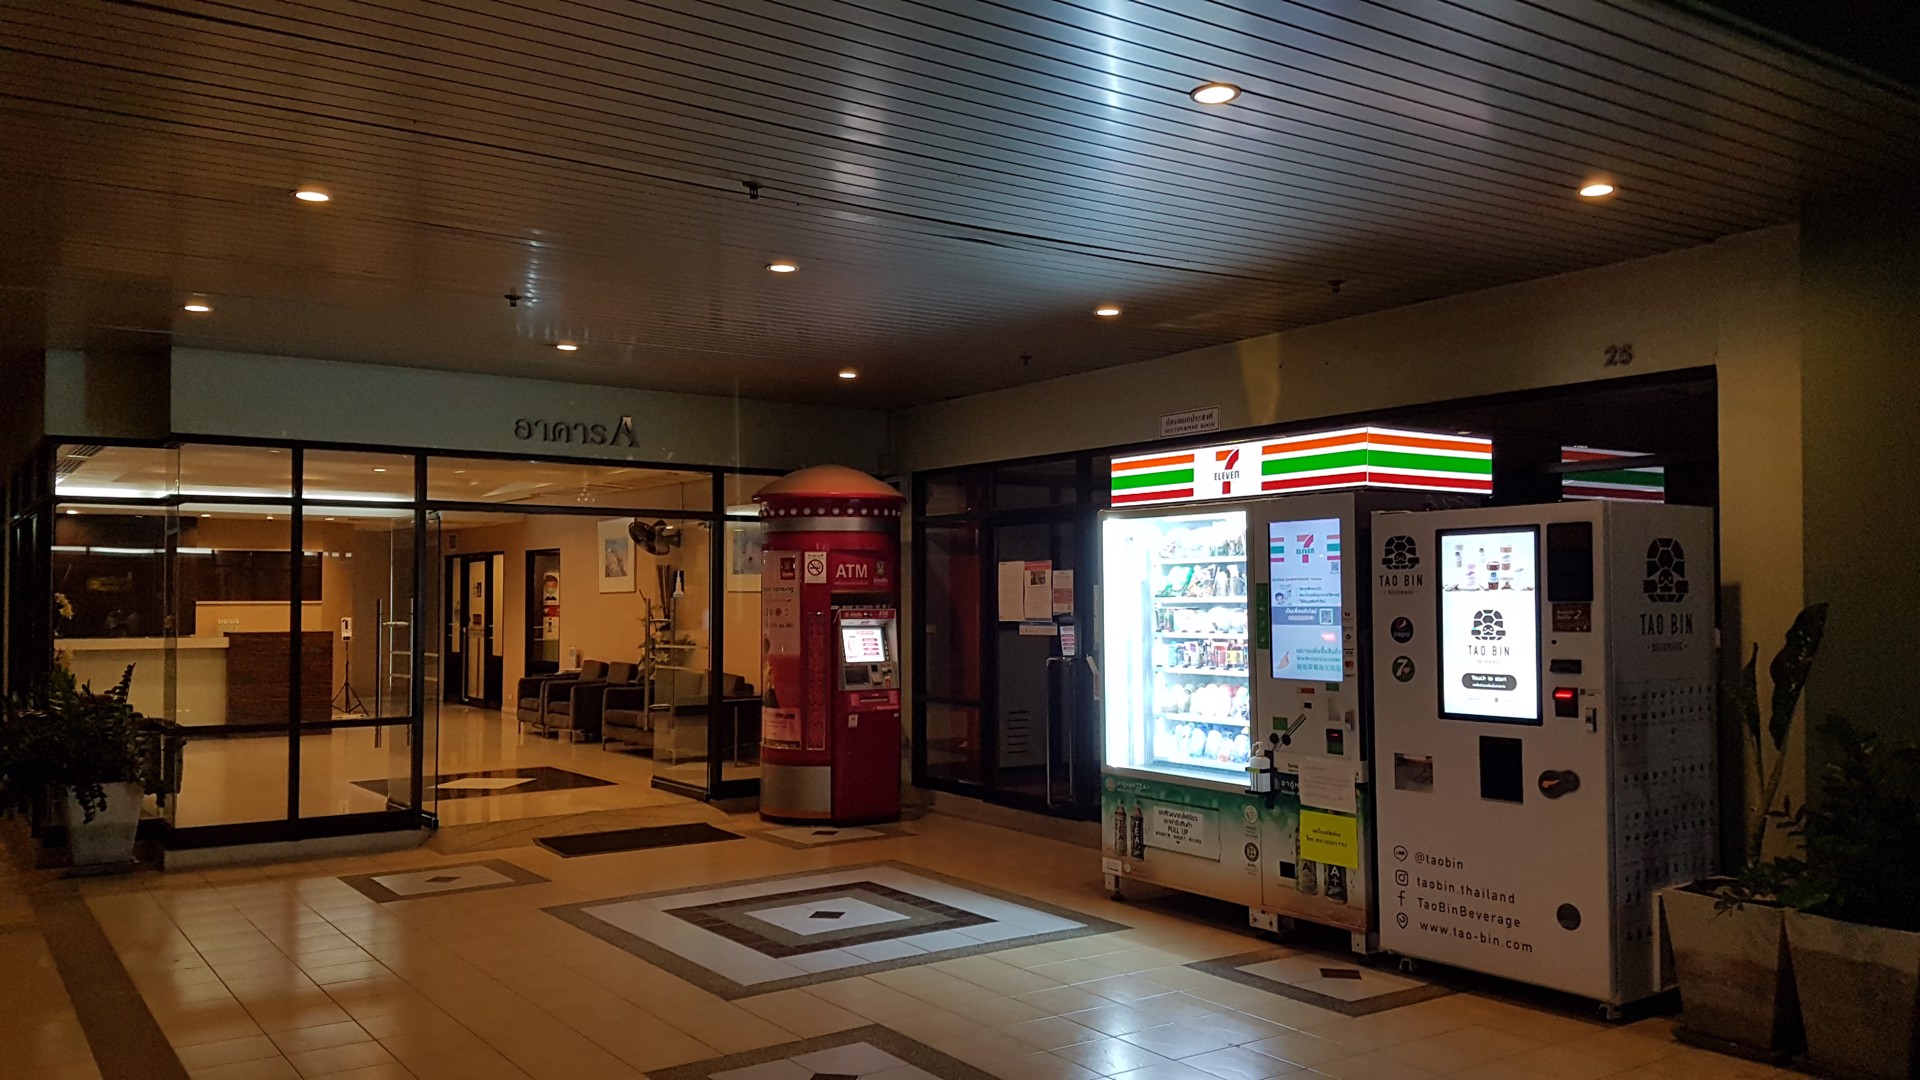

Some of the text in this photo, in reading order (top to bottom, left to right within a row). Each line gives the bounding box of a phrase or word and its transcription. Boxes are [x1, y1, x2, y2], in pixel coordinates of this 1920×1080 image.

[1214, 470, 1240, 481] ELEVEN
[835, 563, 868, 578] ATM
[1379, 574, 1423, 587] TAO BIN
[1640, 613, 1693, 635] TAO BIN
[1468, 645, 1510, 656] TAO BIN
[1167, 825, 1180, 834] PULL
[1415, 851, 1464, 869] @taobin
[1417, 876, 1515, 904] taobin.thailand
[1417, 897, 1521, 929] TaoBinBeverage
[1420, 921, 1533, 953] www.tao-bin.com
